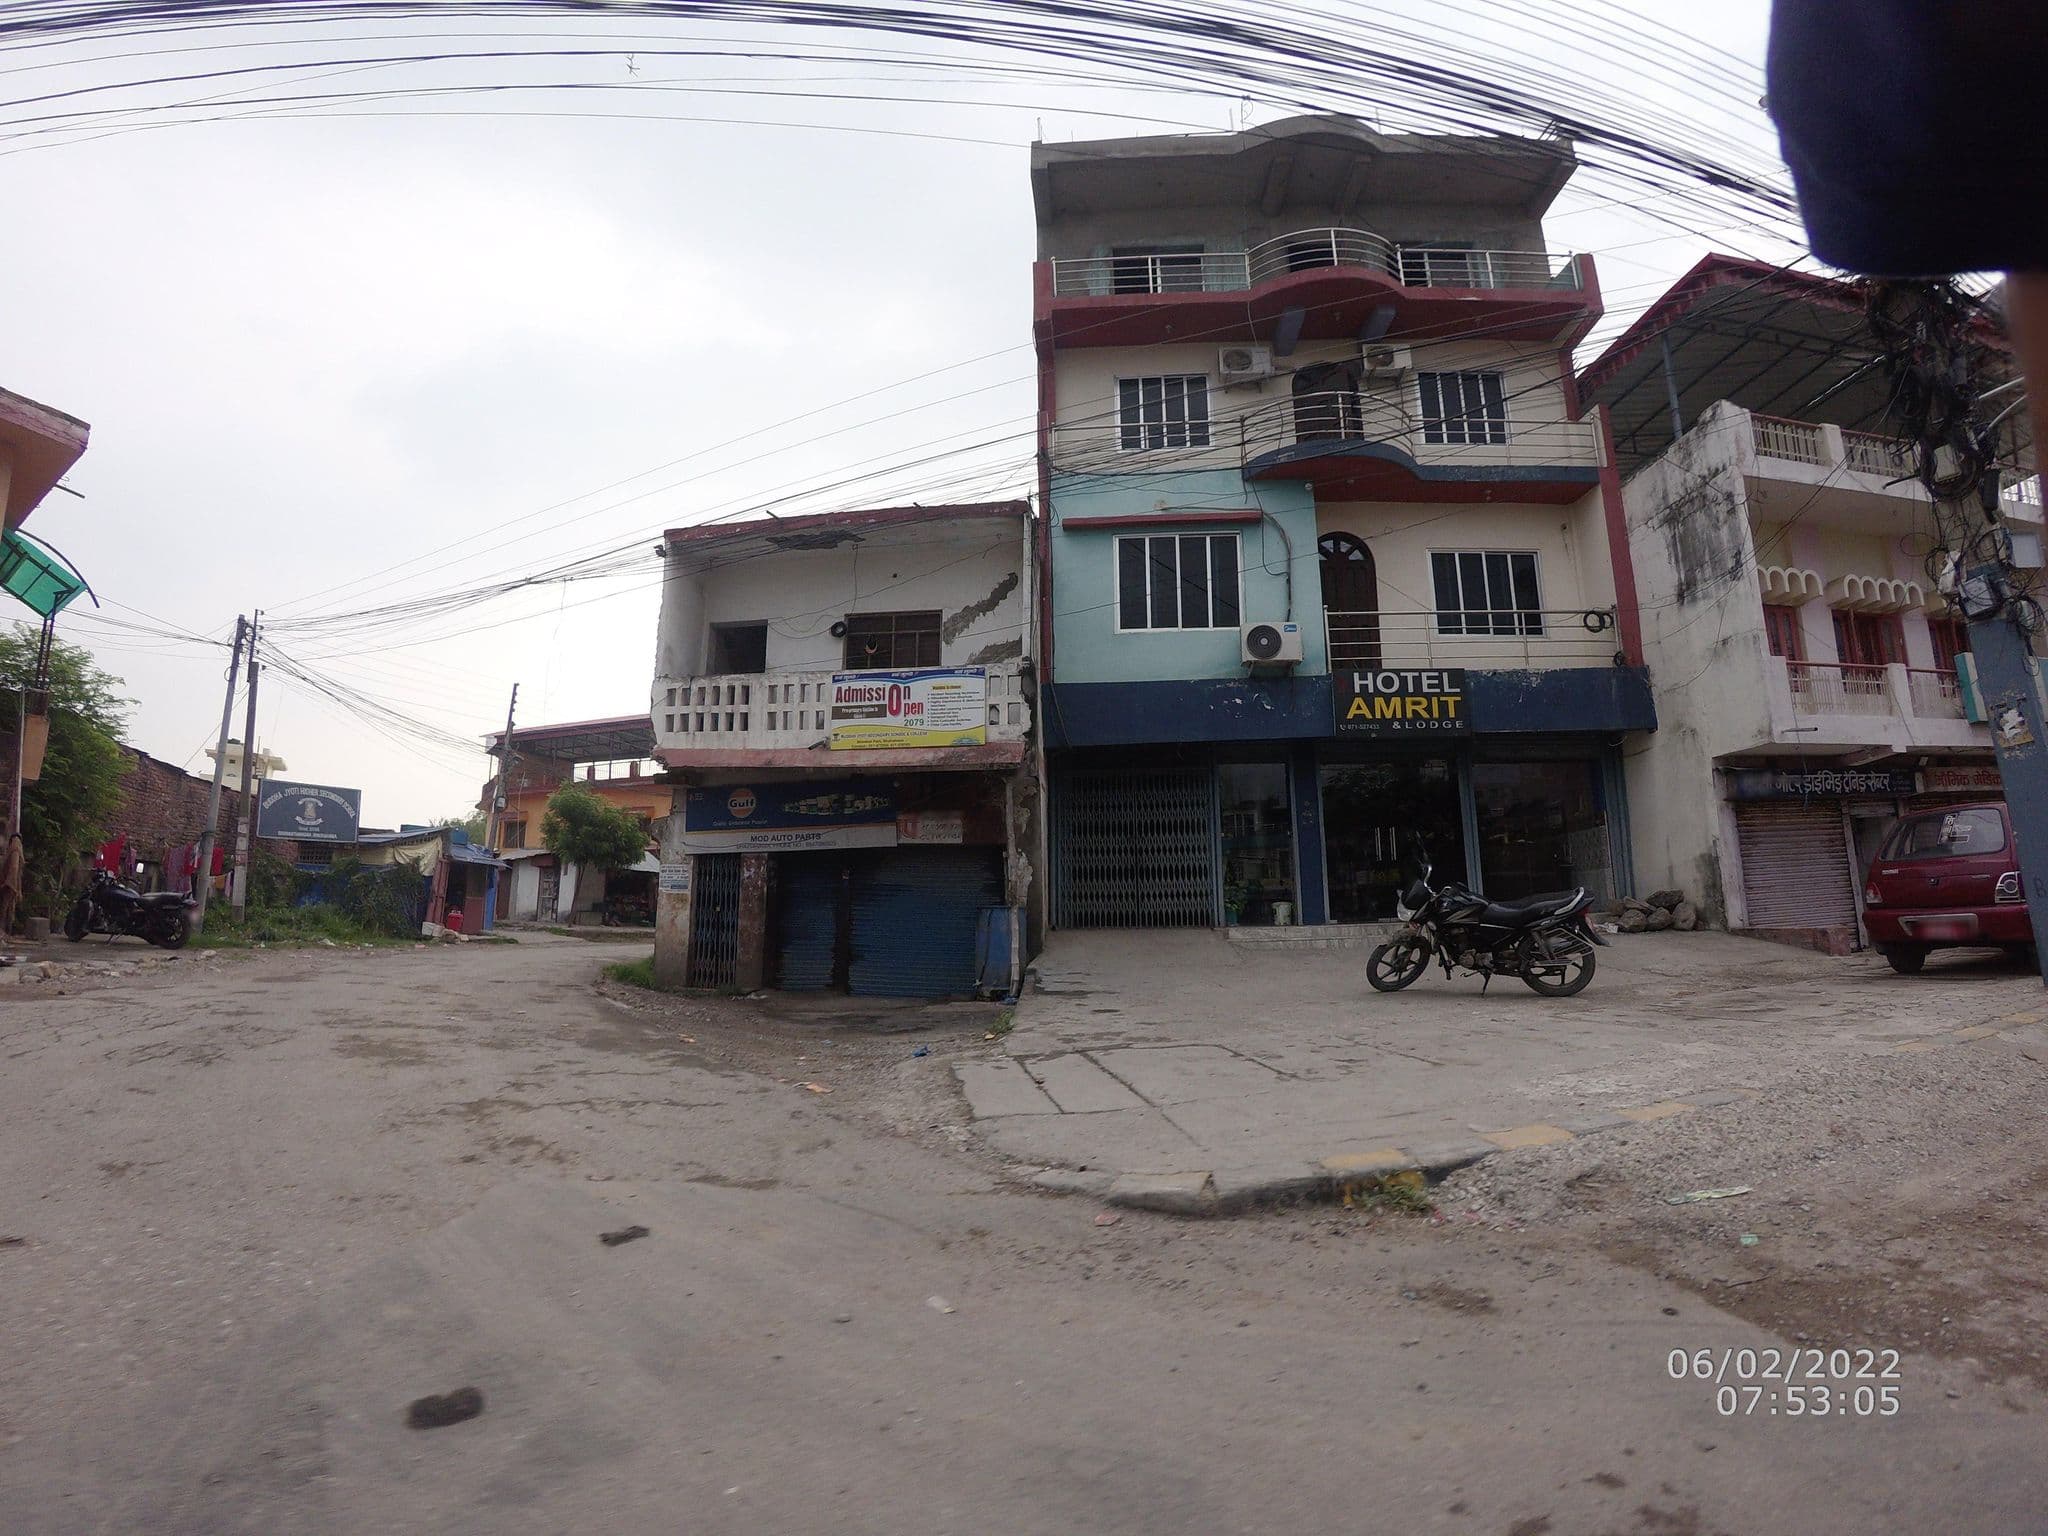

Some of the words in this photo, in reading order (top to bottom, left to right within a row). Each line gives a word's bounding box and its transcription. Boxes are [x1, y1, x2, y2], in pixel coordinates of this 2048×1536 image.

[1353, 671, 1461, 693] HOTEL
[1346, 696, 1462, 719] AMRIT
[904, 718, 925, 727] 2079
[1392, 720, 1401, 729] &
[1405, 720, 1465, 729] LODGE
[284, 787, 299, 797] JYOTI
[729, 798, 755, 808] Gulf
[771, 834, 793, 842] AUTO
[795, 833, 821, 841] PARTS
